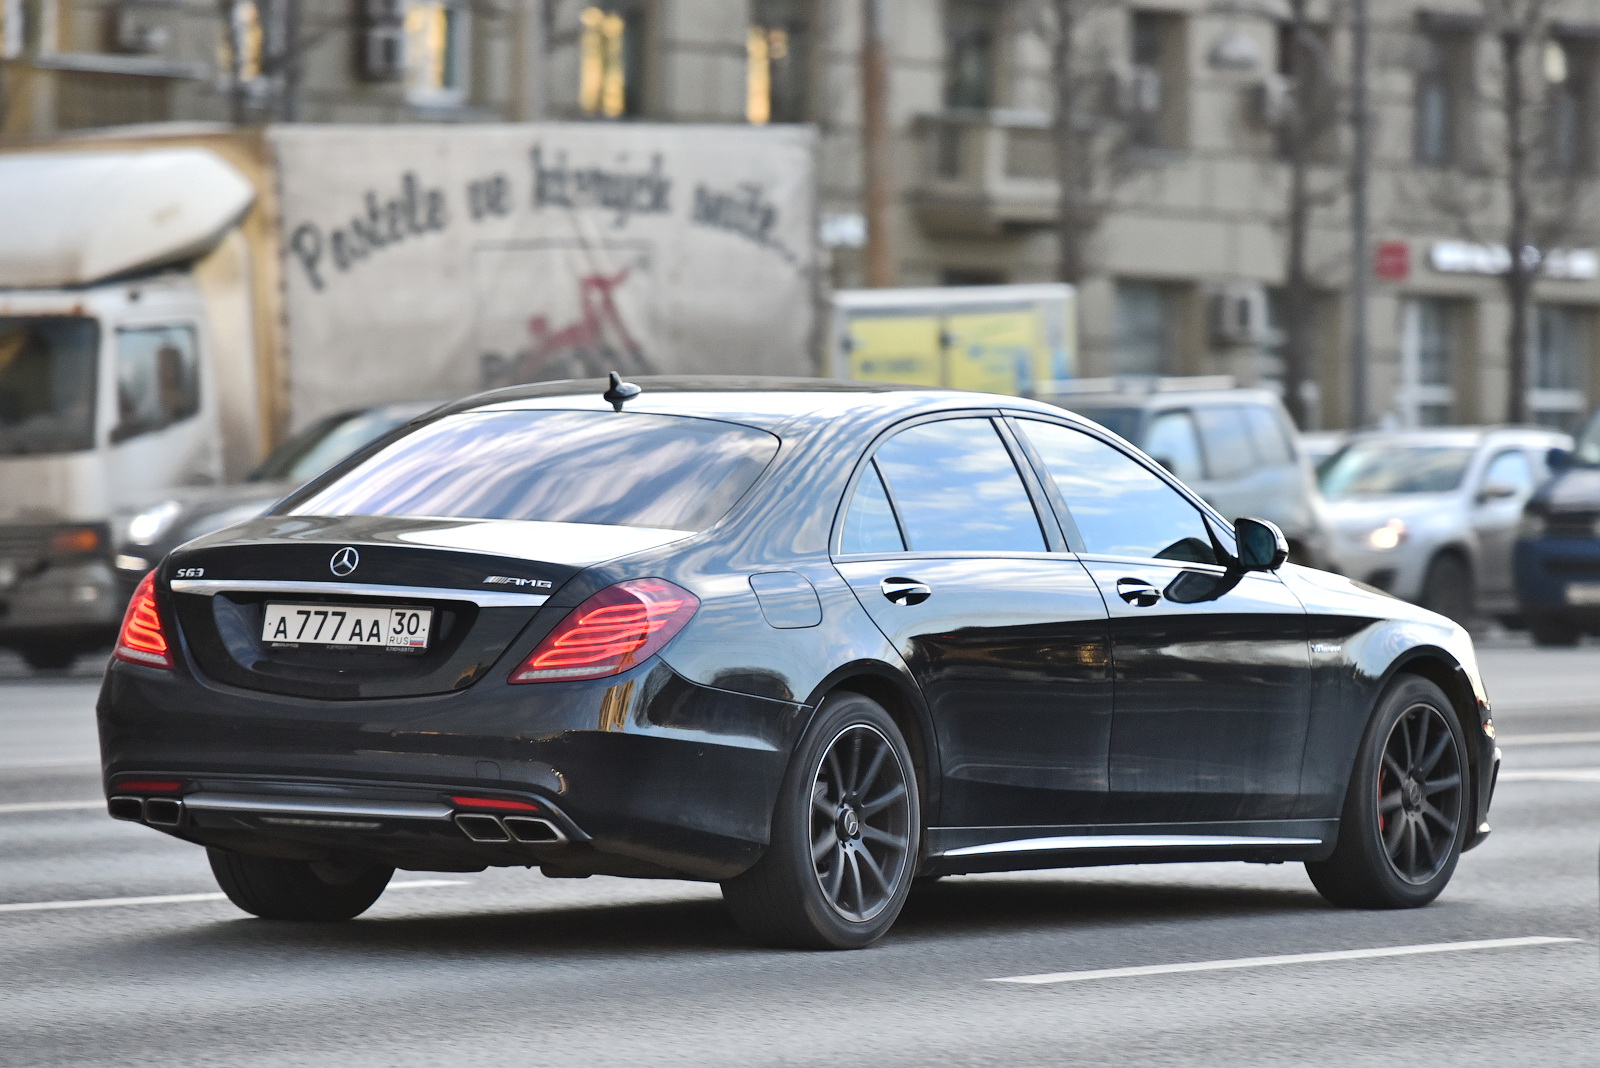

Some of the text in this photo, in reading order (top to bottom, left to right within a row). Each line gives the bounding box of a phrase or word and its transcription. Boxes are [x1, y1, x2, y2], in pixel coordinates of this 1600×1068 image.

[176, 567, 205, 578] S63
[273, 610, 420, 643] A777AA 30
[388, 636, 409, 646] RUS
